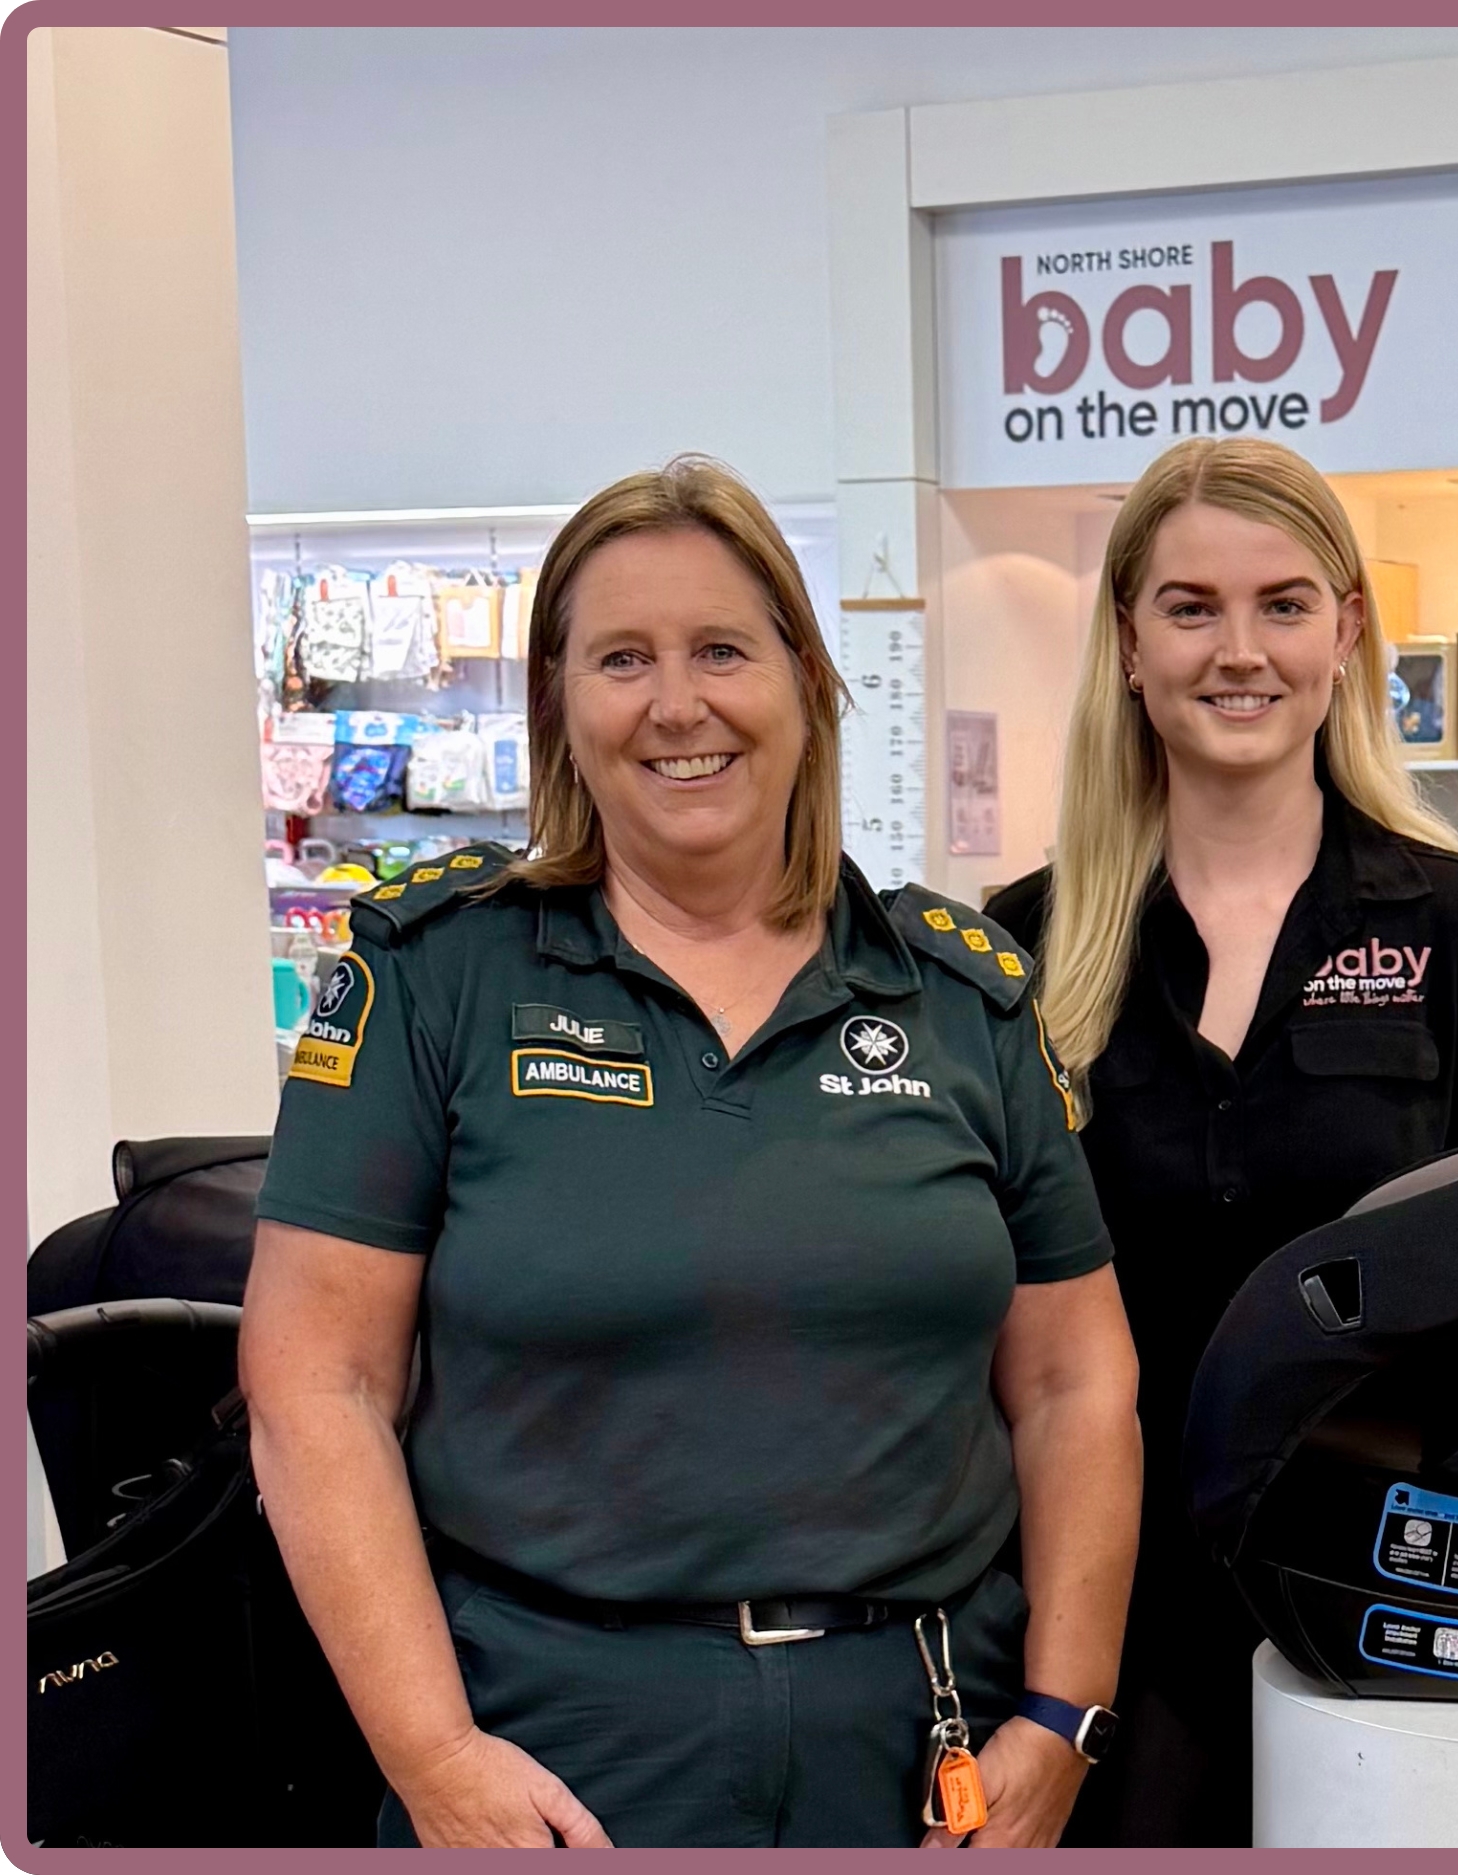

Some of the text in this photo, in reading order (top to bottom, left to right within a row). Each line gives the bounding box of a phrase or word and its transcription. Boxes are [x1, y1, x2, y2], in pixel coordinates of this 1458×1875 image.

[1037, 244, 1194, 276] NORTH SHORE
[1001, 240, 1400, 424] baby
[1004, 391, 1309, 443] on the move
[889, 631, 903, 662] 190
[861, 674, 882, 689] 6
[889, 679, 903, 710] 180
[890, 726, 903, 756] 170
[890, 774, 903, 804] 160
[861, 818, 883, 832] 5
[890, 821, 903, 851] 150
[1327, 975, 1356, 990] the
[1359, 976, 1406, 990] move
[550, 1019, 604, 1045] JULIE
[294, 1050, 339, 1070] BULANCE
[525, 1062, 641, 1092] AMBULANCE
[820, 1073, 931, 1098] St John
